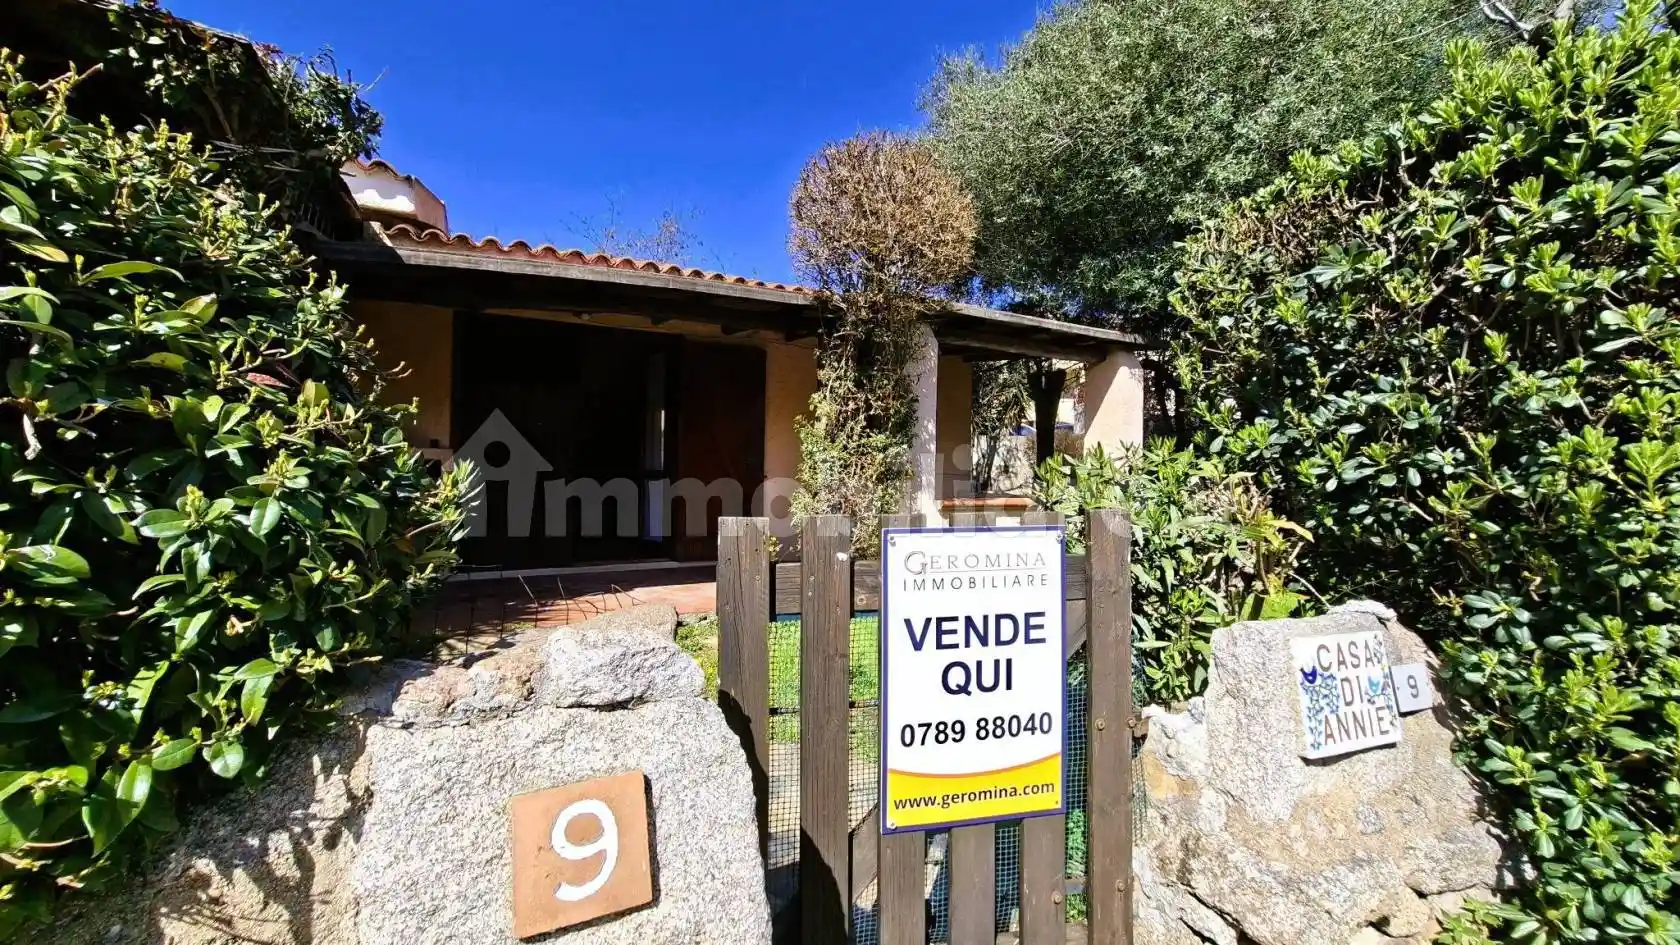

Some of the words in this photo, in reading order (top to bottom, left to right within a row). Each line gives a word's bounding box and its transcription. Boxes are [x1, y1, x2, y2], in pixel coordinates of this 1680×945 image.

[904, 550, 1046, 575] GEROMINA
[903, 574, 1048, 592] IMMOBILIARE
[904, 611, 1046, 651] VENDE
[1316, 639, 1375, 672] CASA
[941, 658, 1013, 696] QUI
[1340, 675, 1364, 707] DI
[1407, 674, 1420, 699] 9
[900, 720, 966, 748] 0789
[975, 712, 1053, 741] 88040
[1324, 706, 1390, 745] ANNIE
[894, 782, 1055, 810] www.geromina.com
[551, 798, 619, 902] 9
